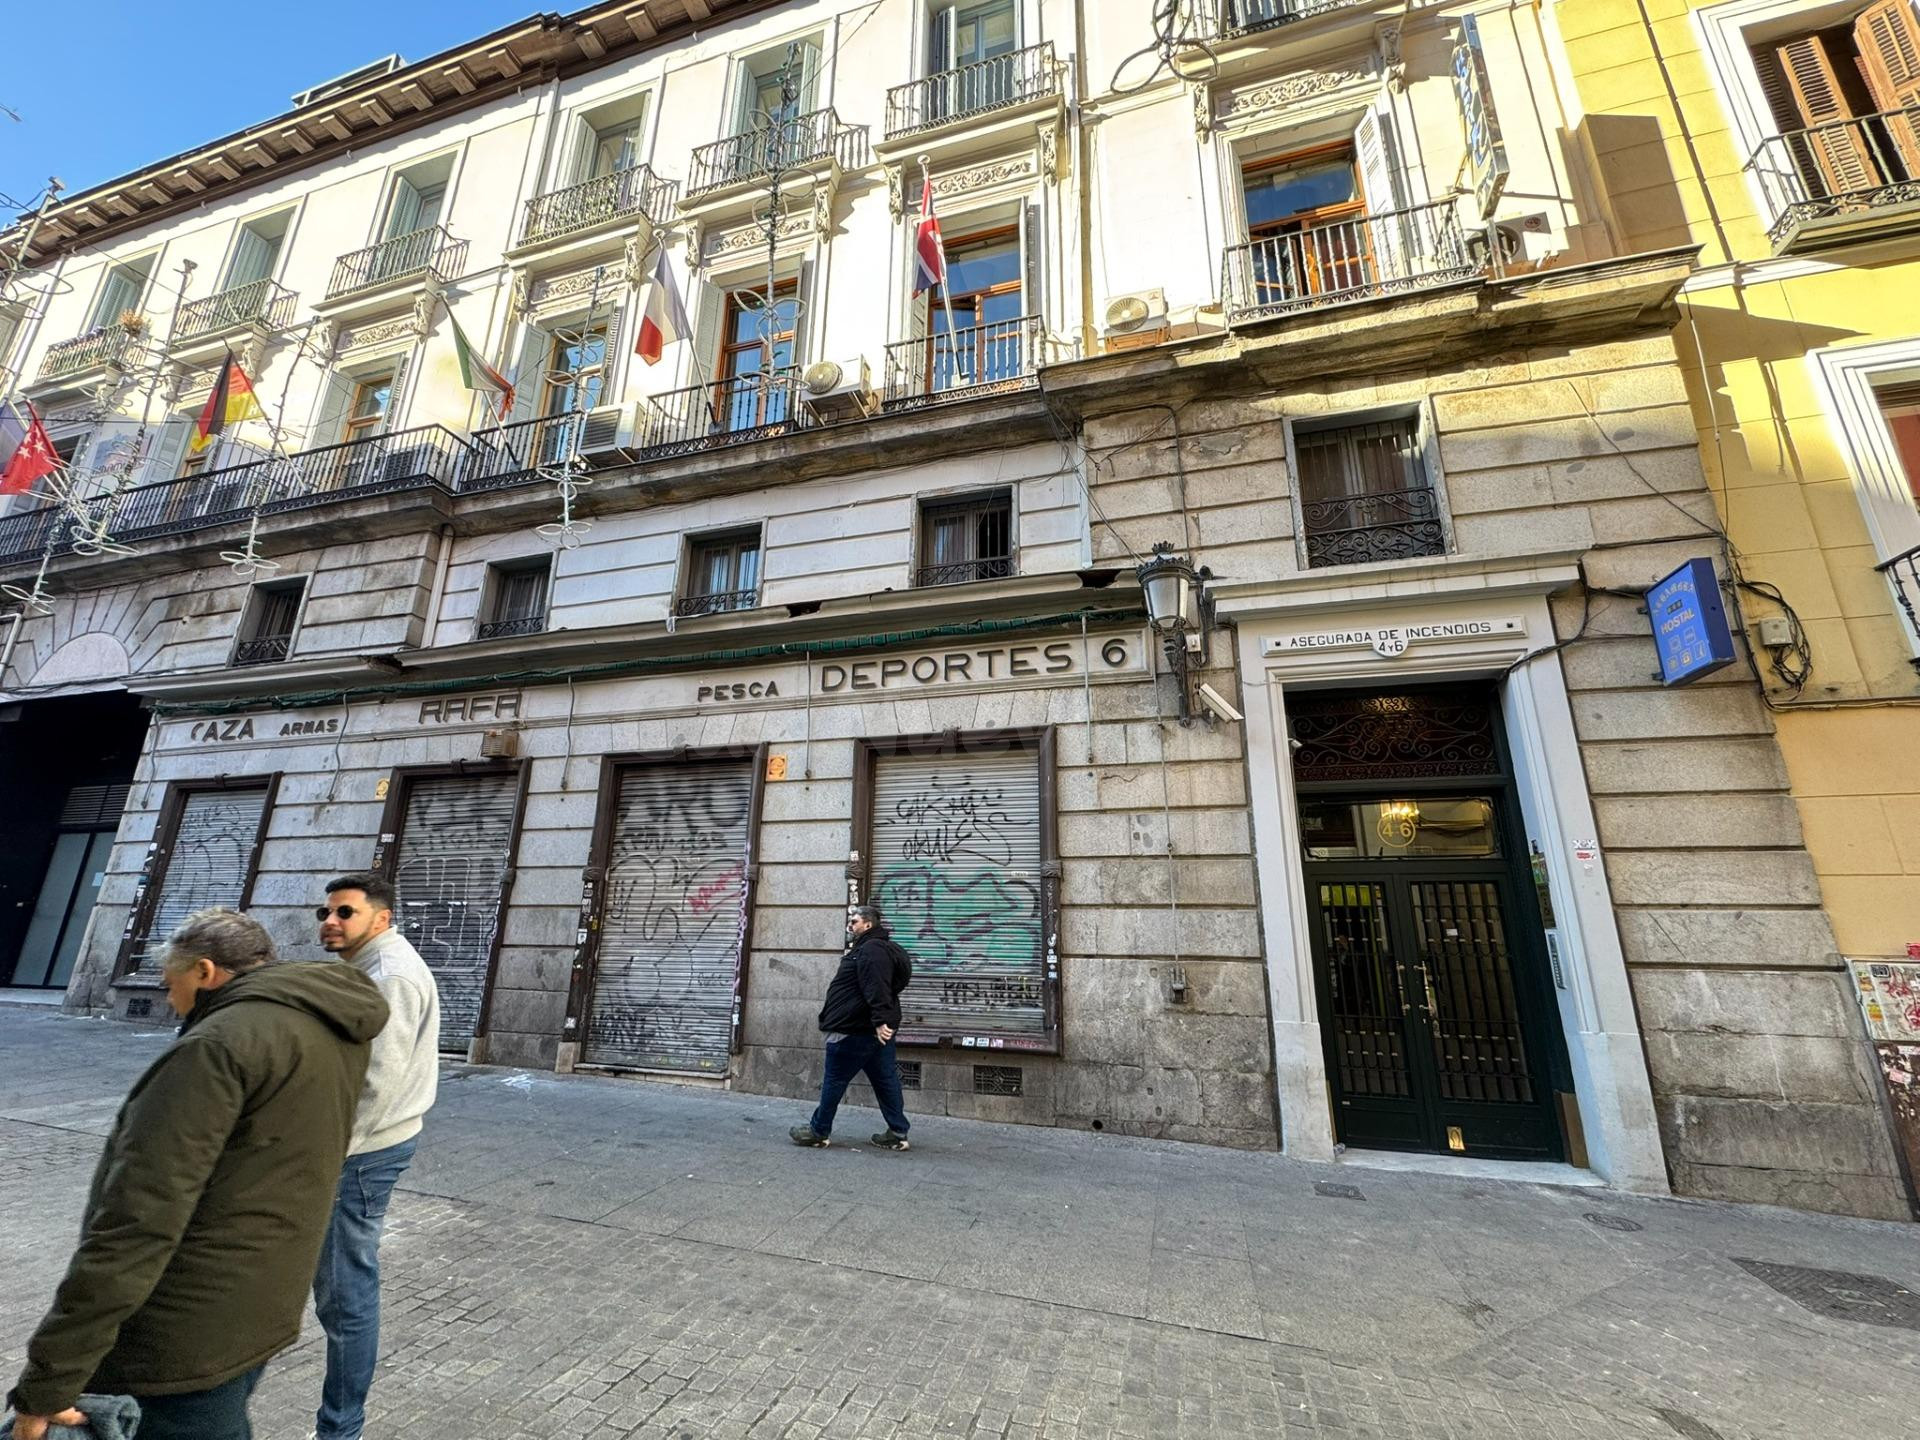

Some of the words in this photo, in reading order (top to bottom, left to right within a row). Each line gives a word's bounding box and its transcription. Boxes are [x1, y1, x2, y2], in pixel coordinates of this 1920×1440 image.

[1291, 633, 1373, 648] ASEGURADA
[1378, 629, 1399, 641] DE
[1405, 621, 1492, 639] INCENDIOS
[1661, 608, 1695, 635] HOSTAL
[279, 718, 339, 737] ARMAS
[418, 694, 521, 725] RAFA
[697, 680, 780, 702] PESCA
[821, 642, 1073, 694] DEPORTES
[1101, 638, 1128, 668] 6
